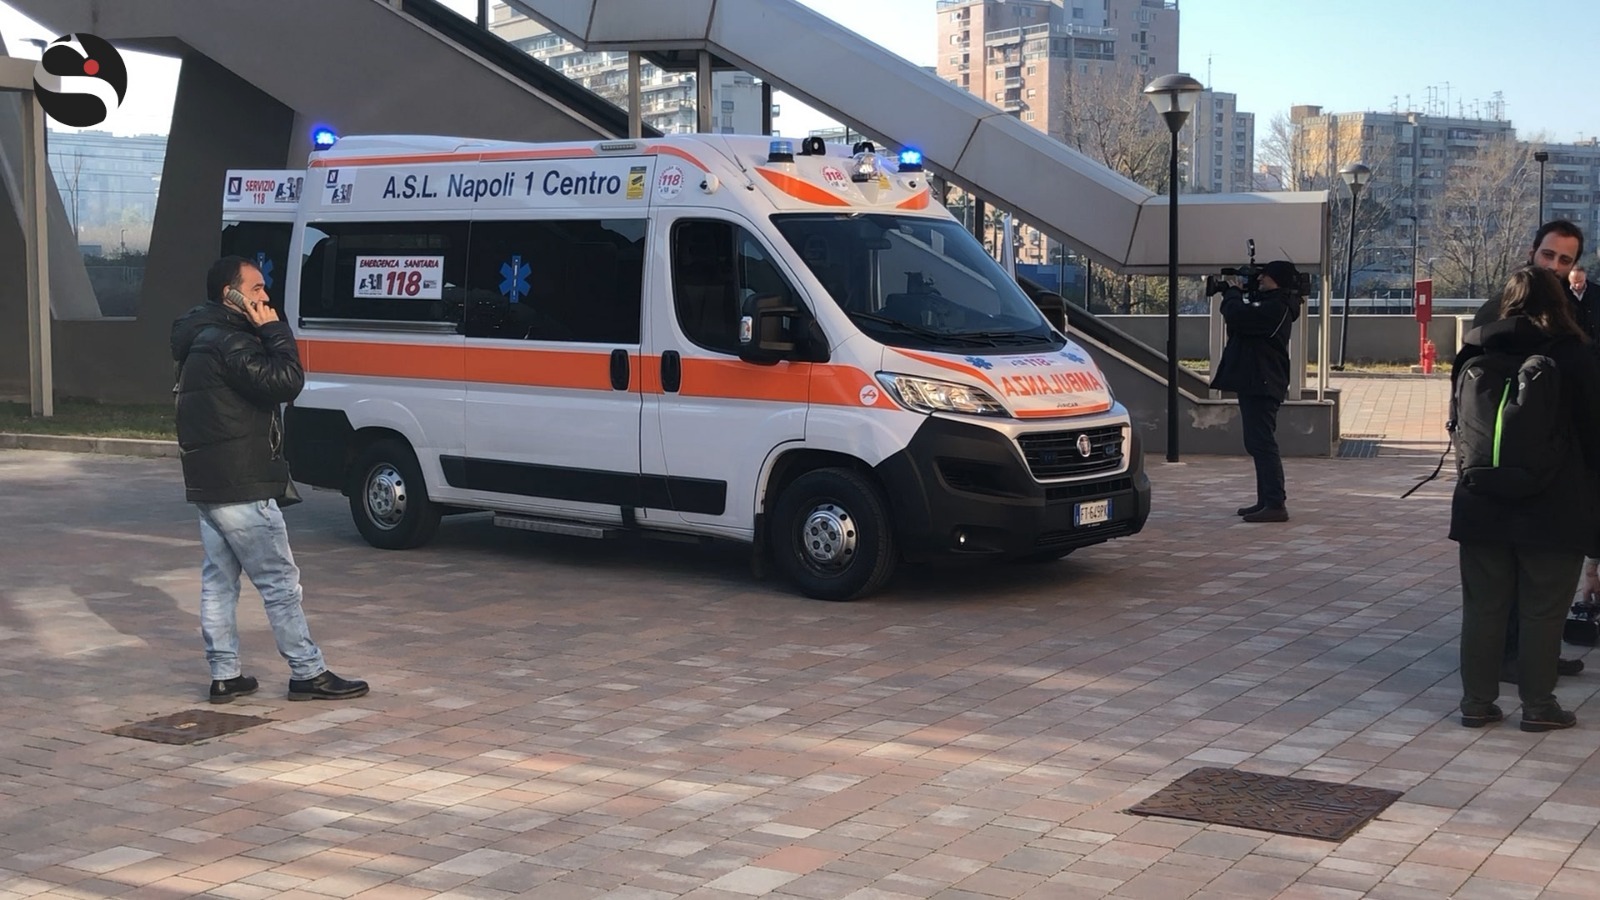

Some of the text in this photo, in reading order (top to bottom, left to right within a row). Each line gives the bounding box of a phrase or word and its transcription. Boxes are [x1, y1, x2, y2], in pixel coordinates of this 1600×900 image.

[662, 174, 681, 186] 118
[825, 171, 844, 182] 118
[245, 180, 276, 192] SERVIZIO
[383, 174, 438, 199] A.S.L.
[447, 172, 516, 202] Napoli
[524, 171, 535, 196] 1
[542, 169, 621, 196] Centro
[253, 192, 266, 204] 118
[359, 259, 439, 268] EMERGENZA SANITARIA
[386, 270, 422, 296] 118
